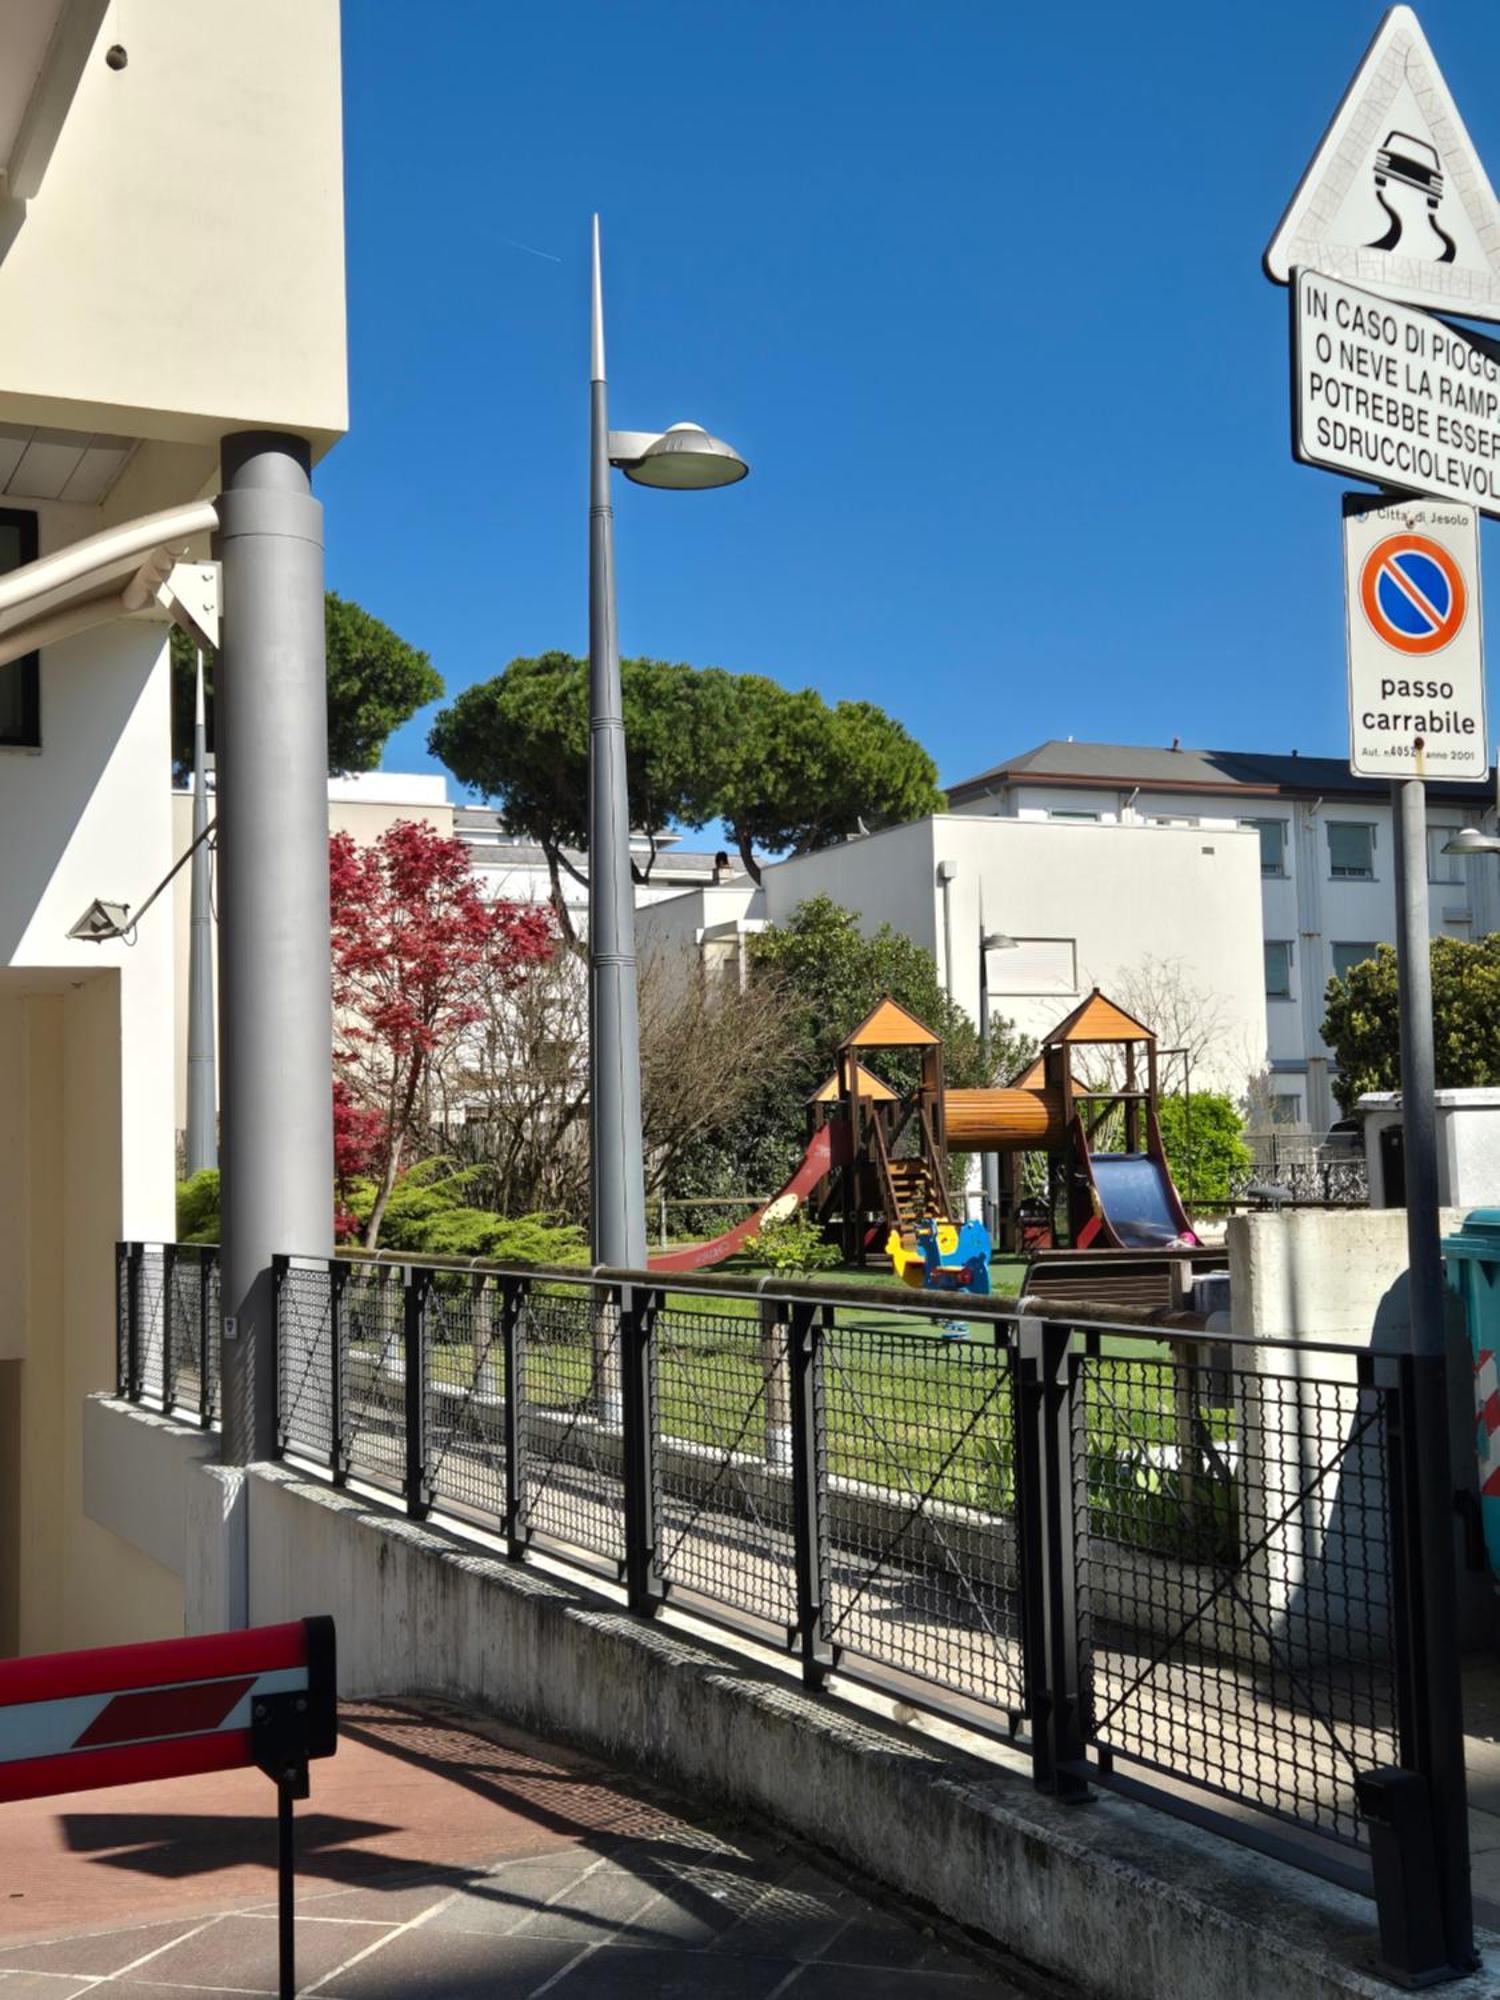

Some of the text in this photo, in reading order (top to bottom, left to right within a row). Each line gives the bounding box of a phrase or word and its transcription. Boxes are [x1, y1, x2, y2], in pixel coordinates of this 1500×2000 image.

[1307, 286, 1500, 382] IN CASO DI PIOGG
[1316, 332, 1500, 424] O NEVE LA RAMP
[1310, 372, 1430, 438] POTREBBE
[1317, 416, 1500, 500] SDRUCCIOLEVOL
[1415, 511, 1426, 523] di
[1431, 513, 1470, 526] Jesolo
[1381, 678, 1453, 700] passo
[1362, 709, 1475, 734] carrabile
[1426, 751, 1448, 760] anno
[1451, 750, 1475, 761] 2001
